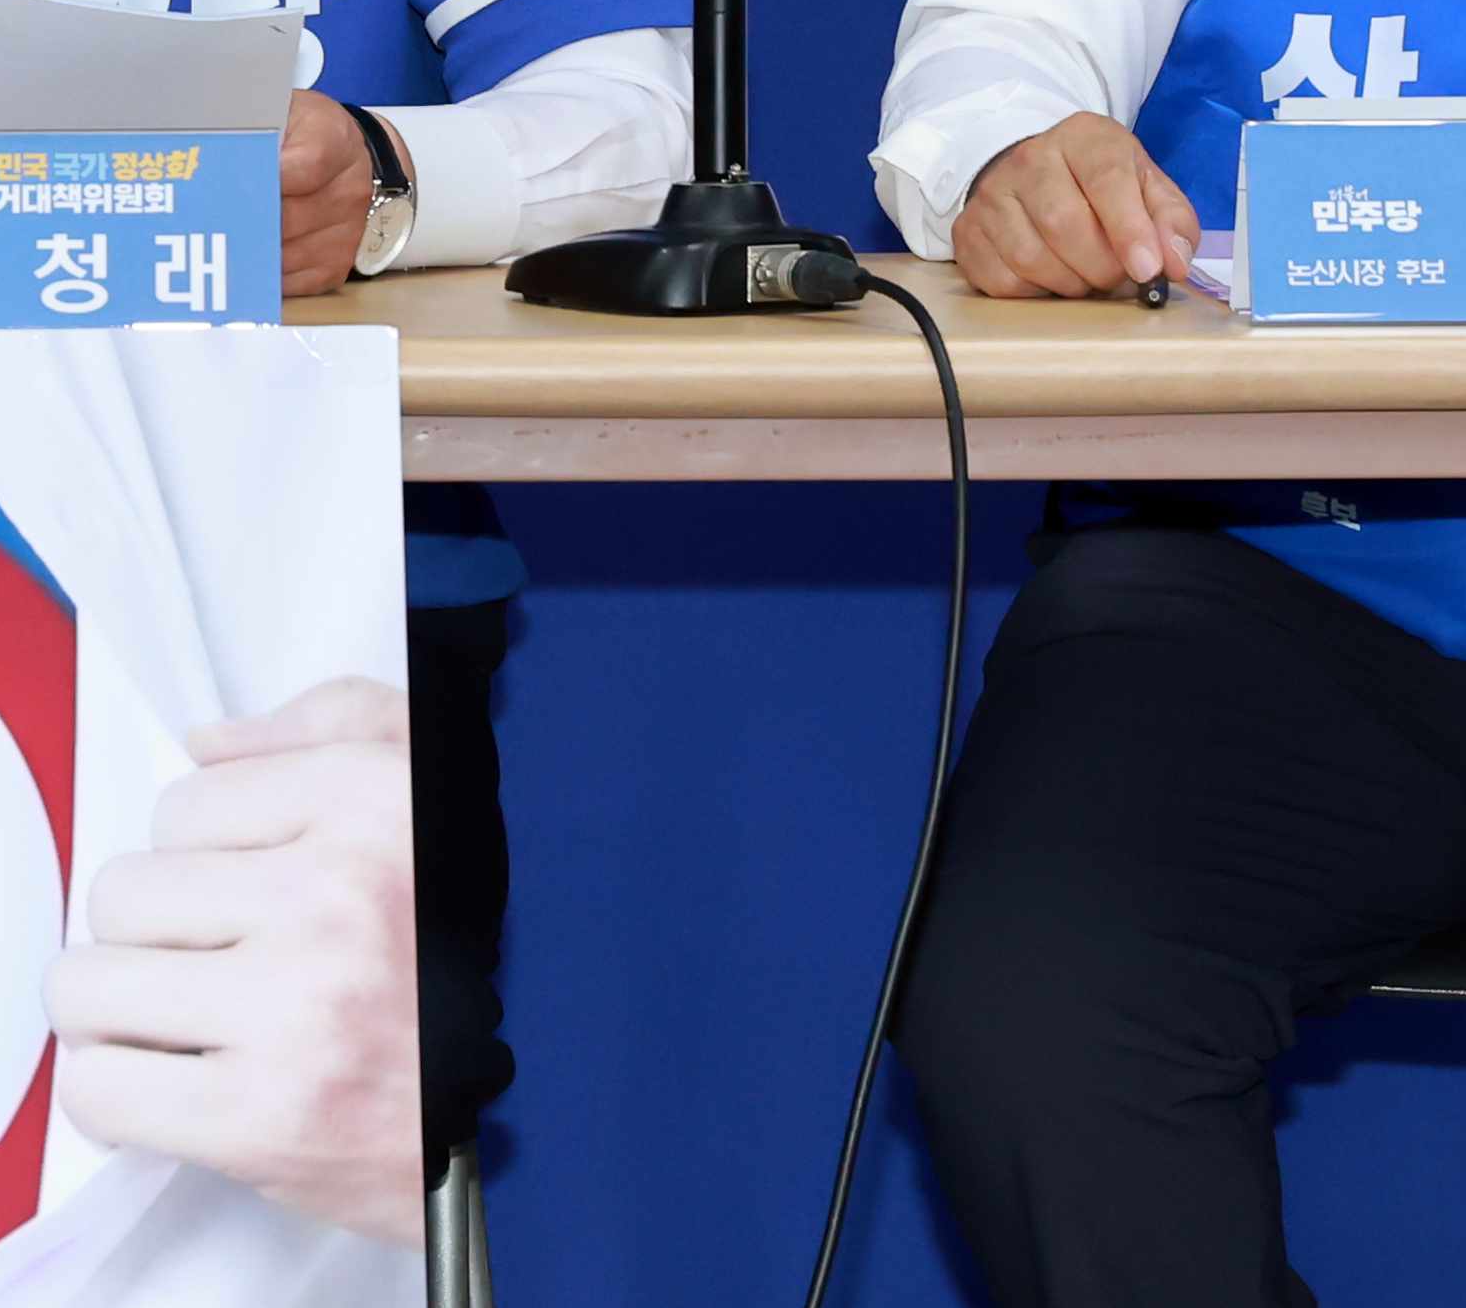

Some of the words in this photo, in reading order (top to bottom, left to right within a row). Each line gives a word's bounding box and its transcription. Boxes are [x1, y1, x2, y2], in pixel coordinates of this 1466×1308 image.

[52, 150, 108, 181] 국가
[111, 145, 201, 181] 정상화
[1312, 199, 1423, 233] 민주당
[1286, 258, 1386, 286] 논산시장
[1396, 258, 1447, 286] 후보
